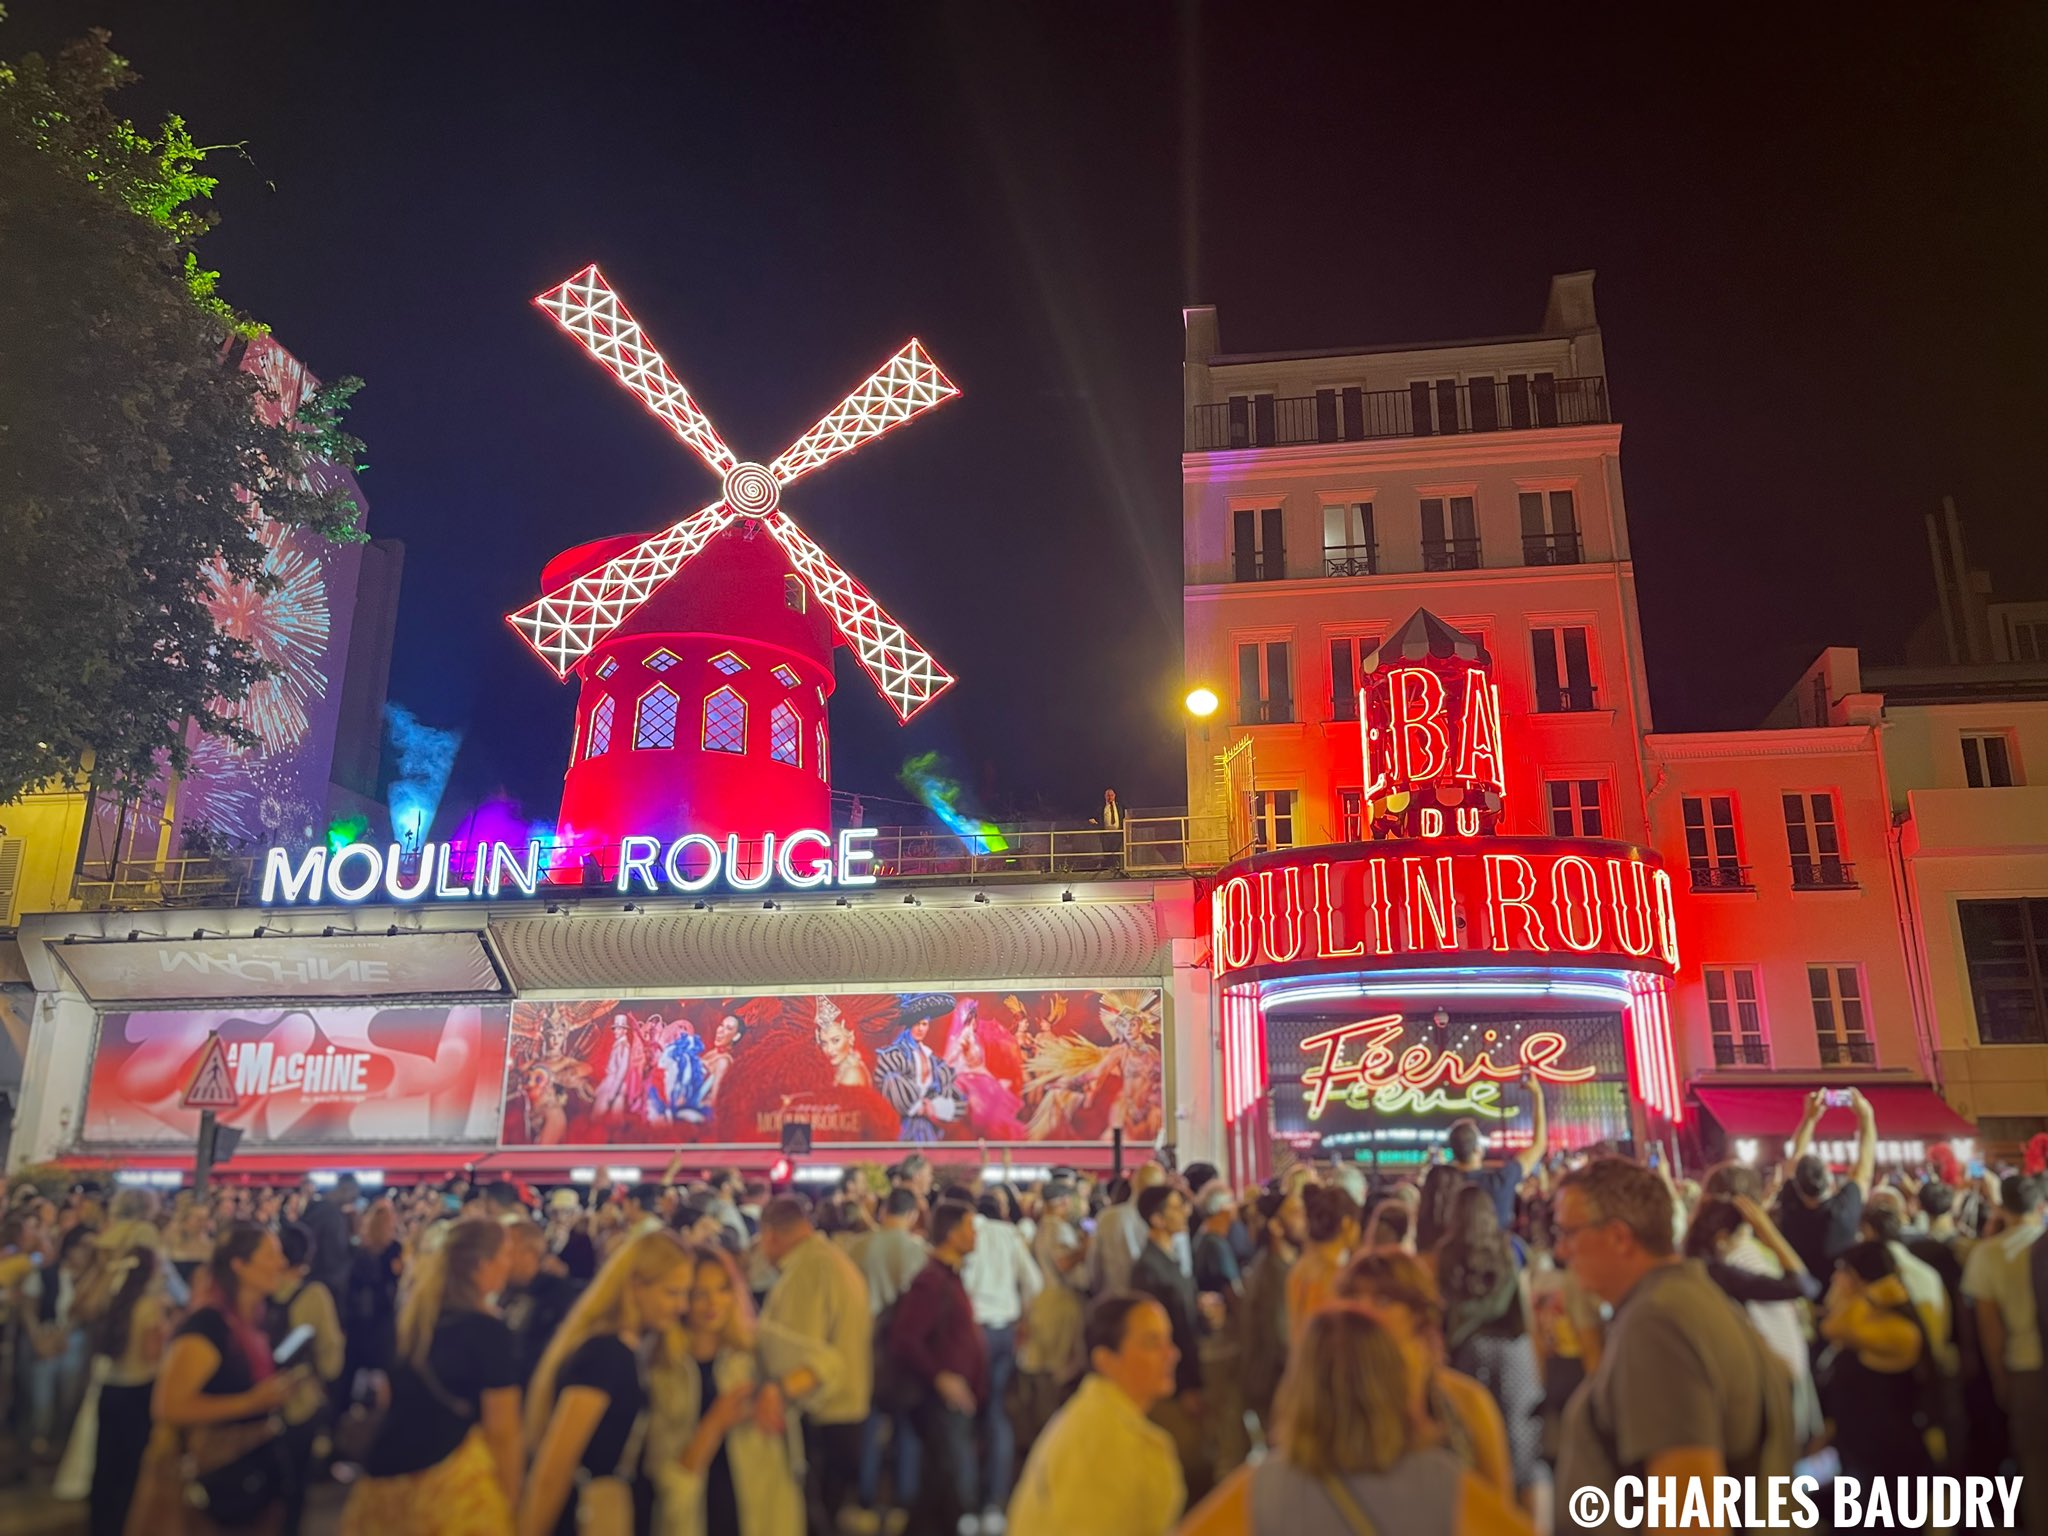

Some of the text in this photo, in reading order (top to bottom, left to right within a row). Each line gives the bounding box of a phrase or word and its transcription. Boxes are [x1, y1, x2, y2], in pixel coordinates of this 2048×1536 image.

[1421, 807, 1479, 837] DU
[262, 828, 878, 901] MOULIN ROUGE
[1300, 1014, 1596, 1119] Féerie
